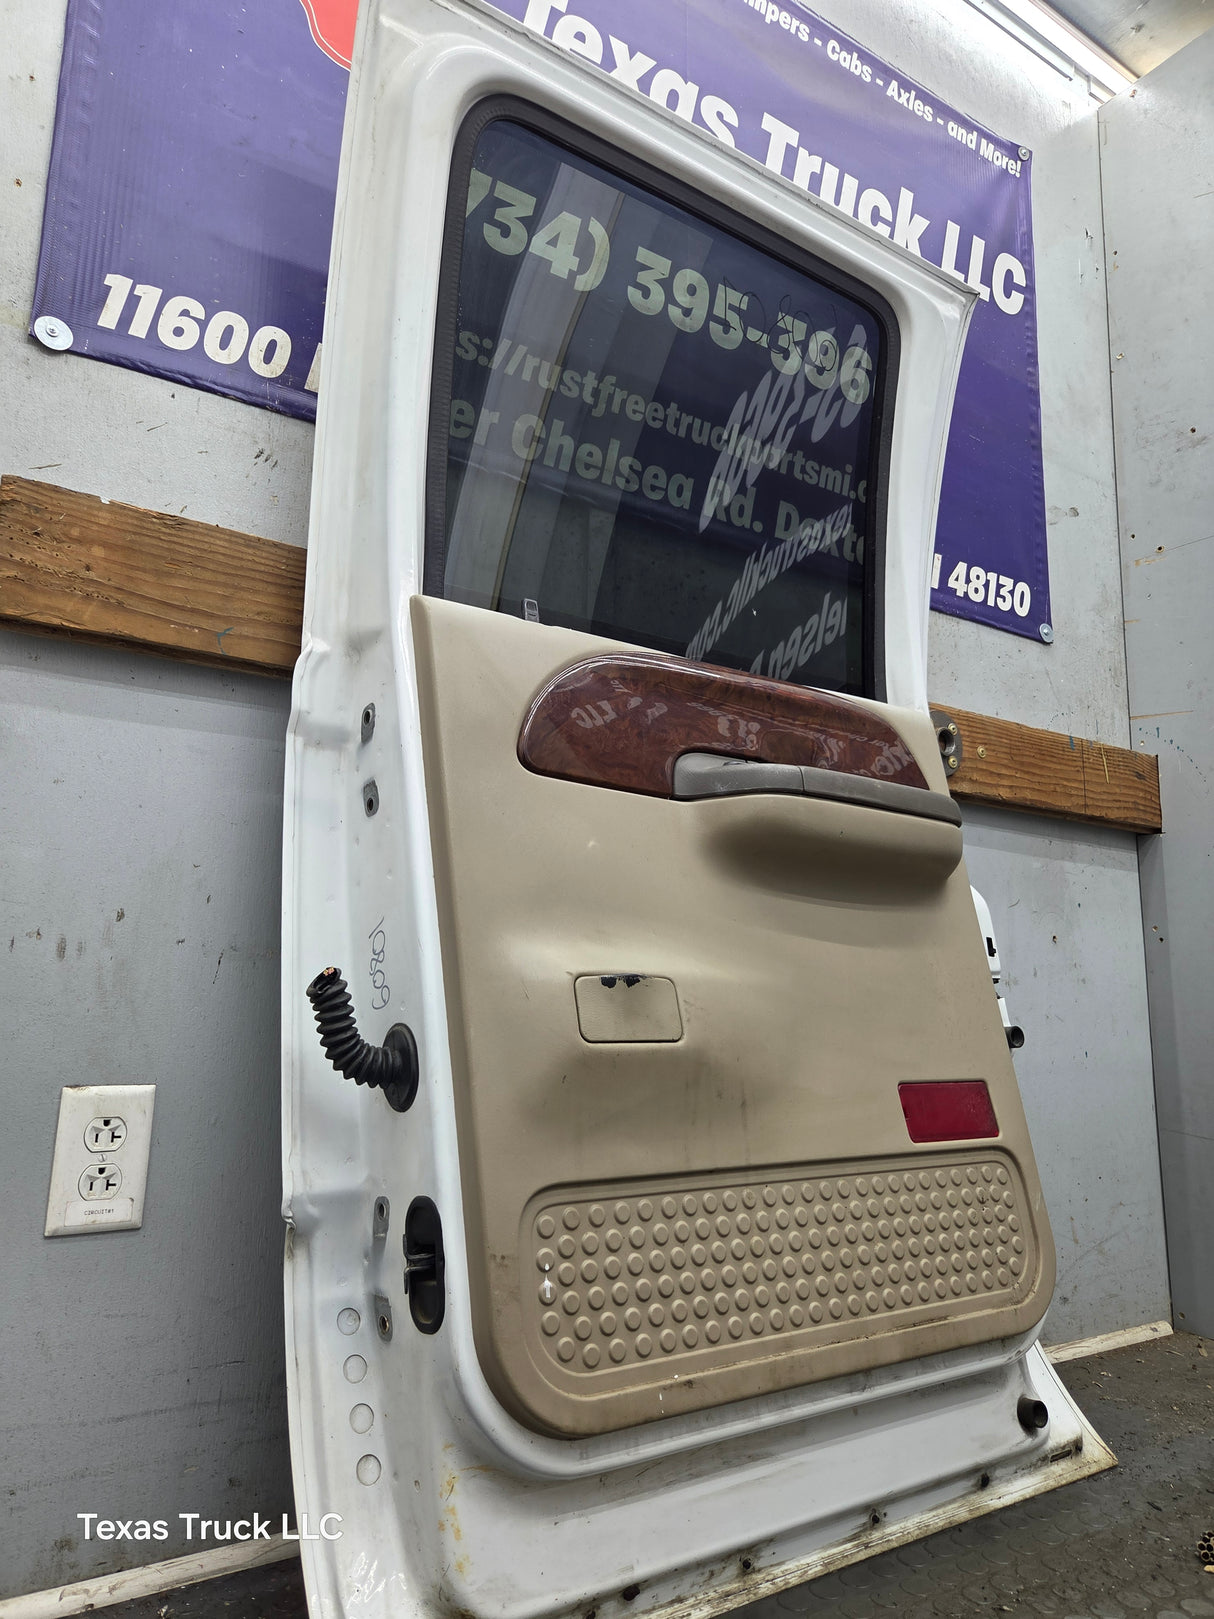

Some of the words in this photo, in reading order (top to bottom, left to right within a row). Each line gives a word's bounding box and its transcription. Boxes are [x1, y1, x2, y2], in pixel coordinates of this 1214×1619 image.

[826, 39, 873, 83] Cabs
[886, 79, 934, 122] Axles
[947, 120, 978, 151] and
[979, 137, 1022, 178] More!
[760, 111, 931, 260] Truck
[940, 219, 1027, 316] LLC
[96, 273, 293, 379] 11600
[511, 413, 696, 510] Chelsea
[947, 560, 1031, 618] 48130
